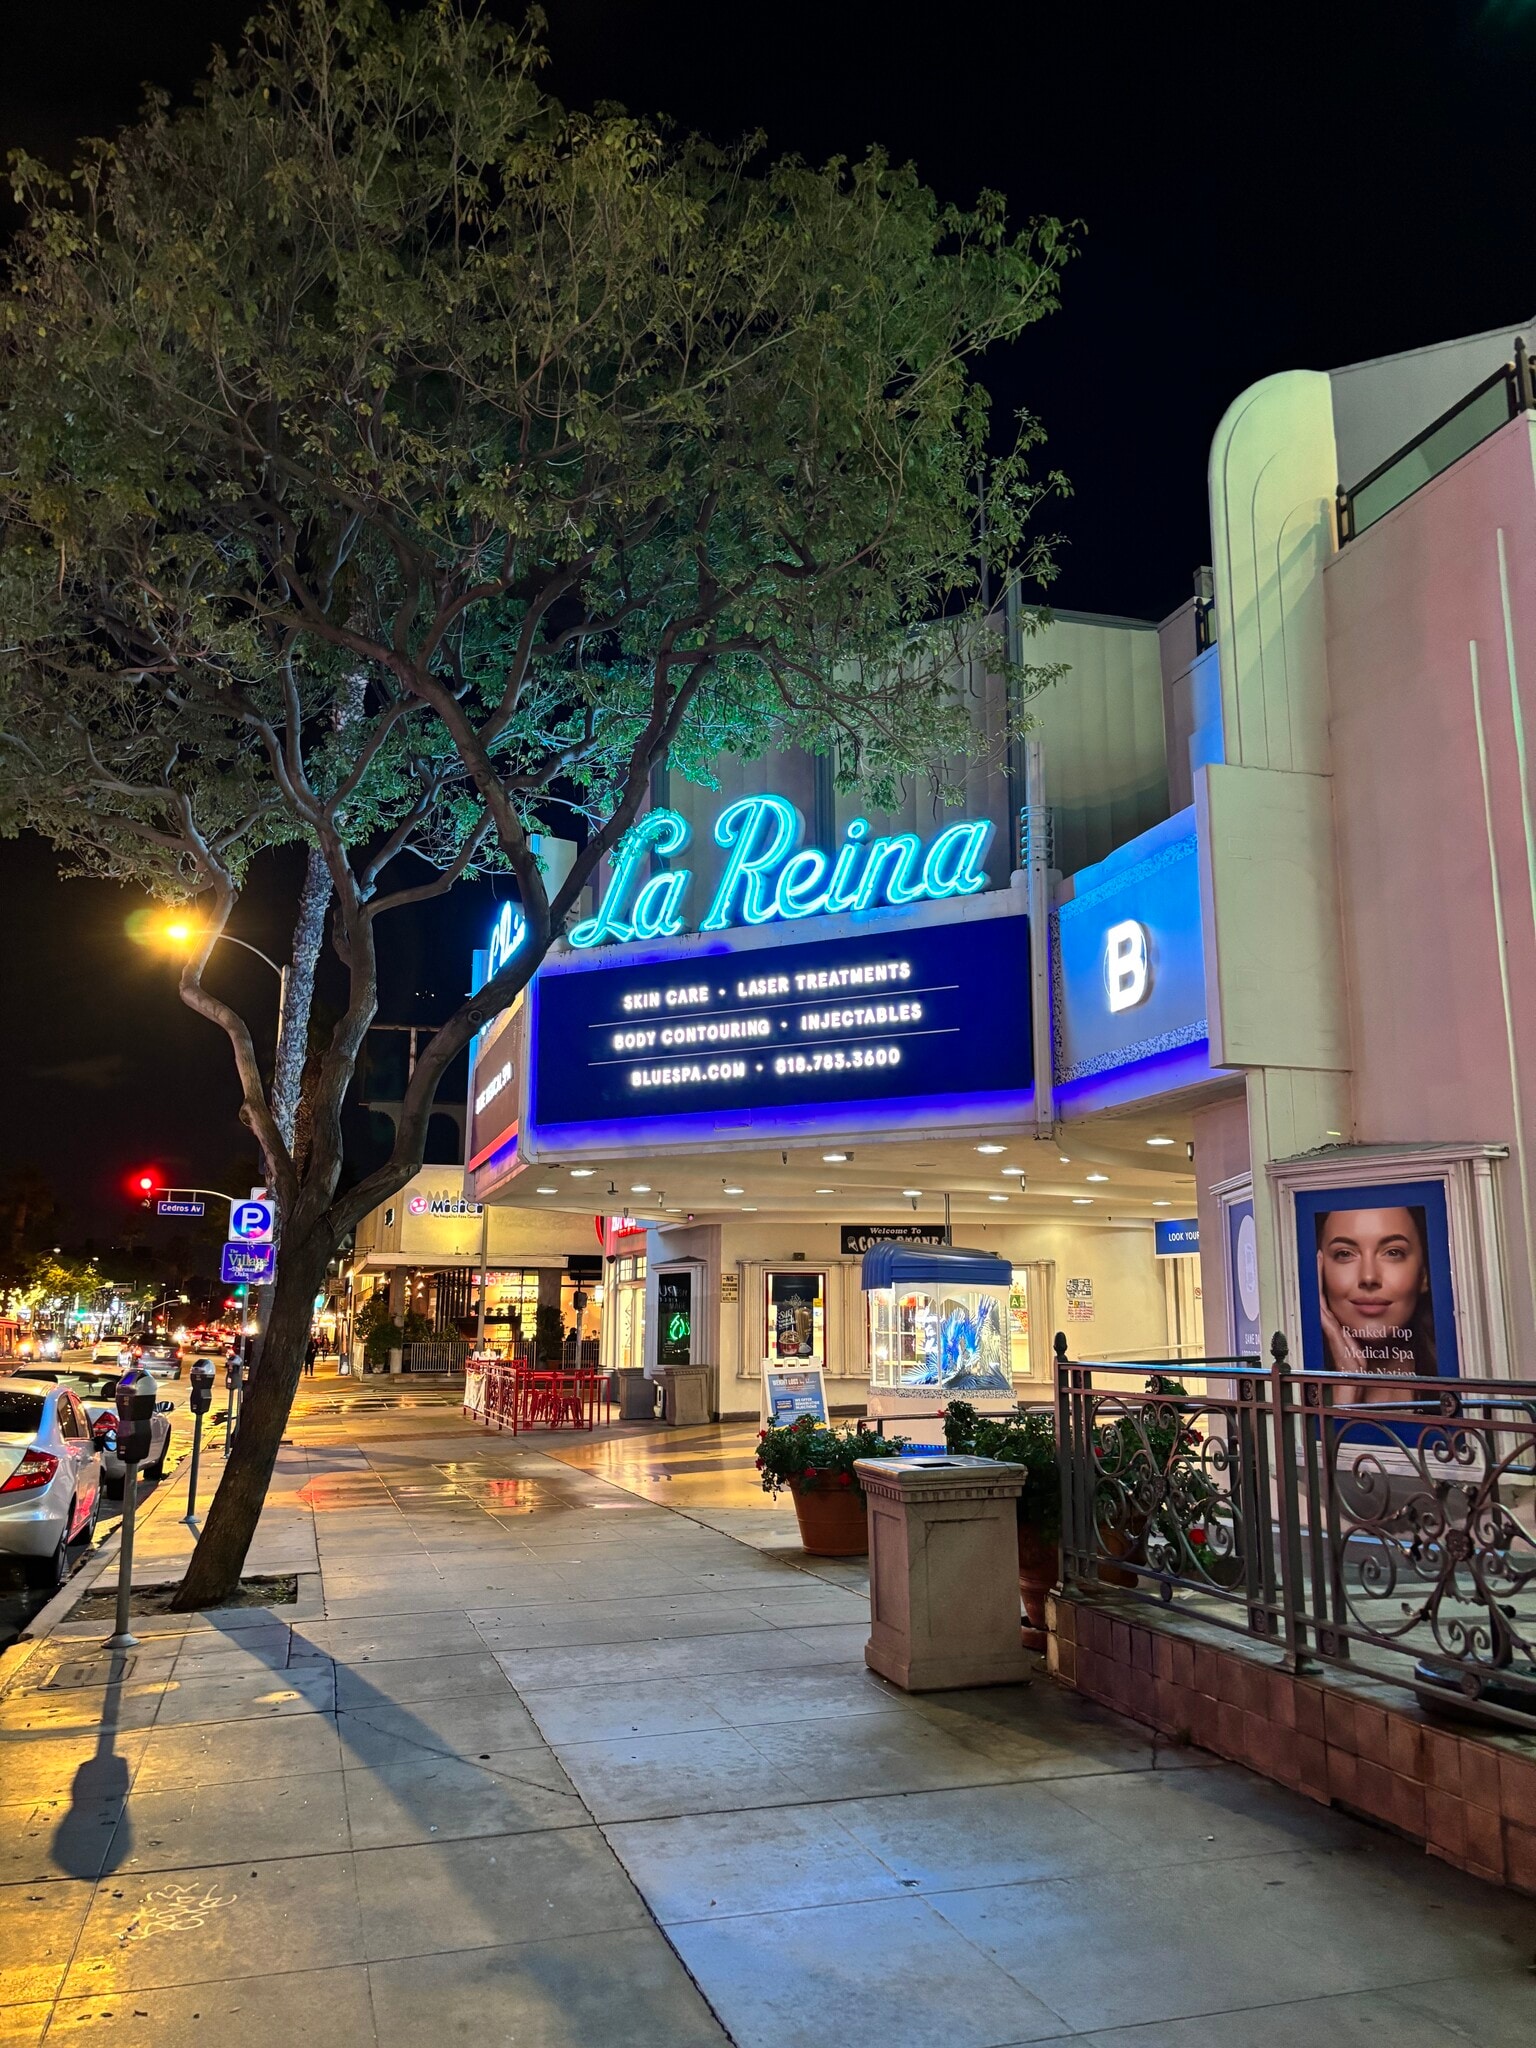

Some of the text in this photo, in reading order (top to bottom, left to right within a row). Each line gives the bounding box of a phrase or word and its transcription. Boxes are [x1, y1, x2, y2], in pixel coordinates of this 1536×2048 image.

[568, 807, 692, 948] La
[699, 793, 997, 930] Reina
[1106, 919, 1147, 1013] B
[623, 962, 911, 1010] SKIN CARE LASER TREATMENTS
[613, 1003, 922, 1050] BODY CONTOURING INJECTABLES
[631, 1048, 901, 1087] BLUESPA.COM 818.783.3600
[161, 1204, 201, 1213] Cedros Av
[241, 1207, 264, 1233] P
[1168, 1232, 1184, 1242] LOOK
[228, 1253, 269, 1268] Village
[1011, 1297, 1019, 1306] A
[1342, 1325, 1413, 1341] Ranked Top
[1344, 1345, 1414, 1362] Medical Spa
